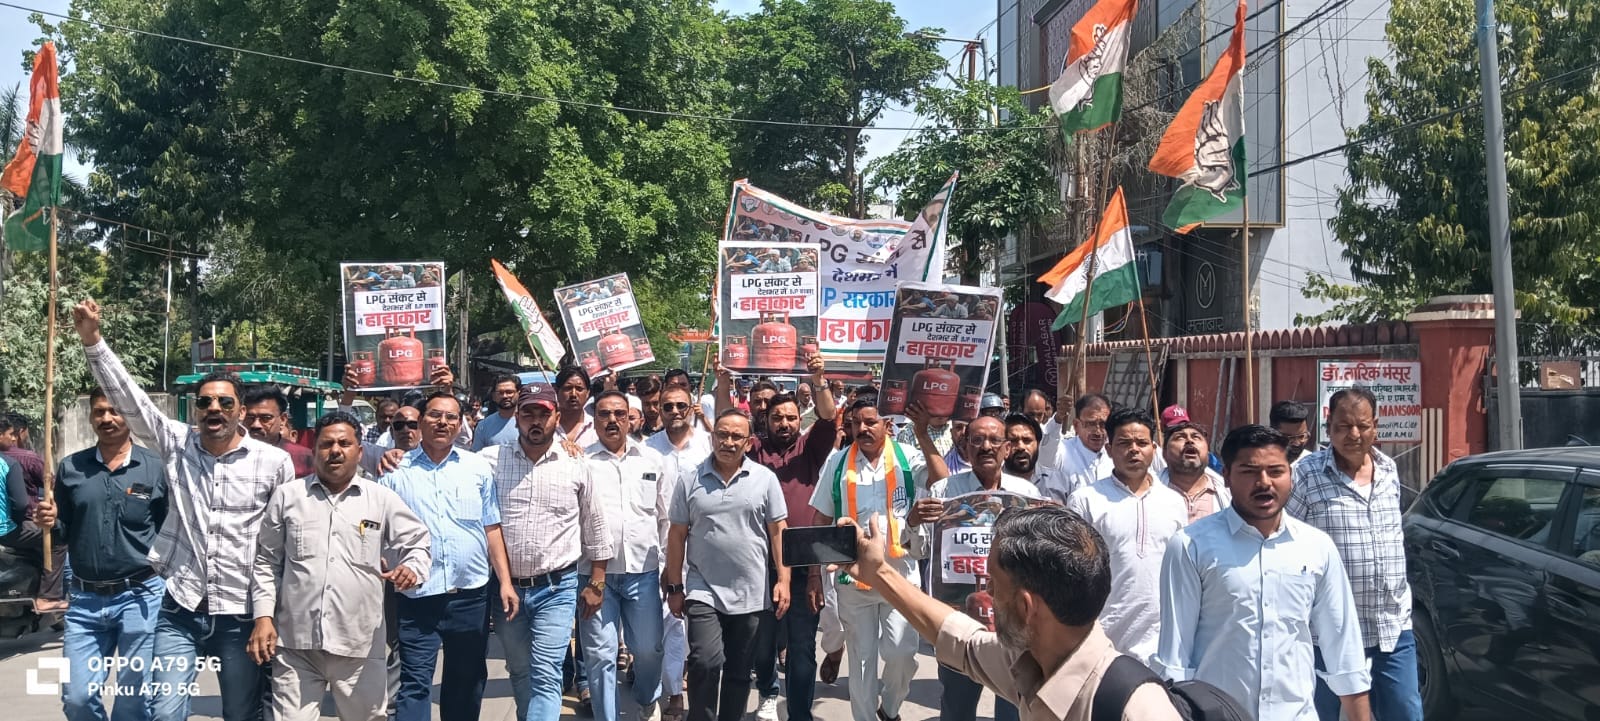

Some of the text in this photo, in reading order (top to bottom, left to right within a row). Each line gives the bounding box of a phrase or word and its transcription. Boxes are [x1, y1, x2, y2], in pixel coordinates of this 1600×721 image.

[742, 275, 802, 288] LPG संकट से
[366, 290, 427, 304] LPG संकट से
[739, 296, 806, 311] हाहाकार
[578, 307, 593, 316] LPG
[363, 310, 431, 327] हाहाकार
[580, 311, 630, 332] हाहाकार
[912, 321, 976, 334] LPG संकट से
[606, 343, 625, 353] LPG
[906, 341, 977, 358] हाहाकार
[1039, 319, 1051, 367] MALABAR
[389, 350, 413, 358] LPG
[1383, 364, 1412, 383] मंसूर
[923, 381, 948, 391] LPG
[1173, 407, 1185, 417] NY
[1379, 405, 1421, 416] MANSOOR
[954, 533, 977, 544] LPG
